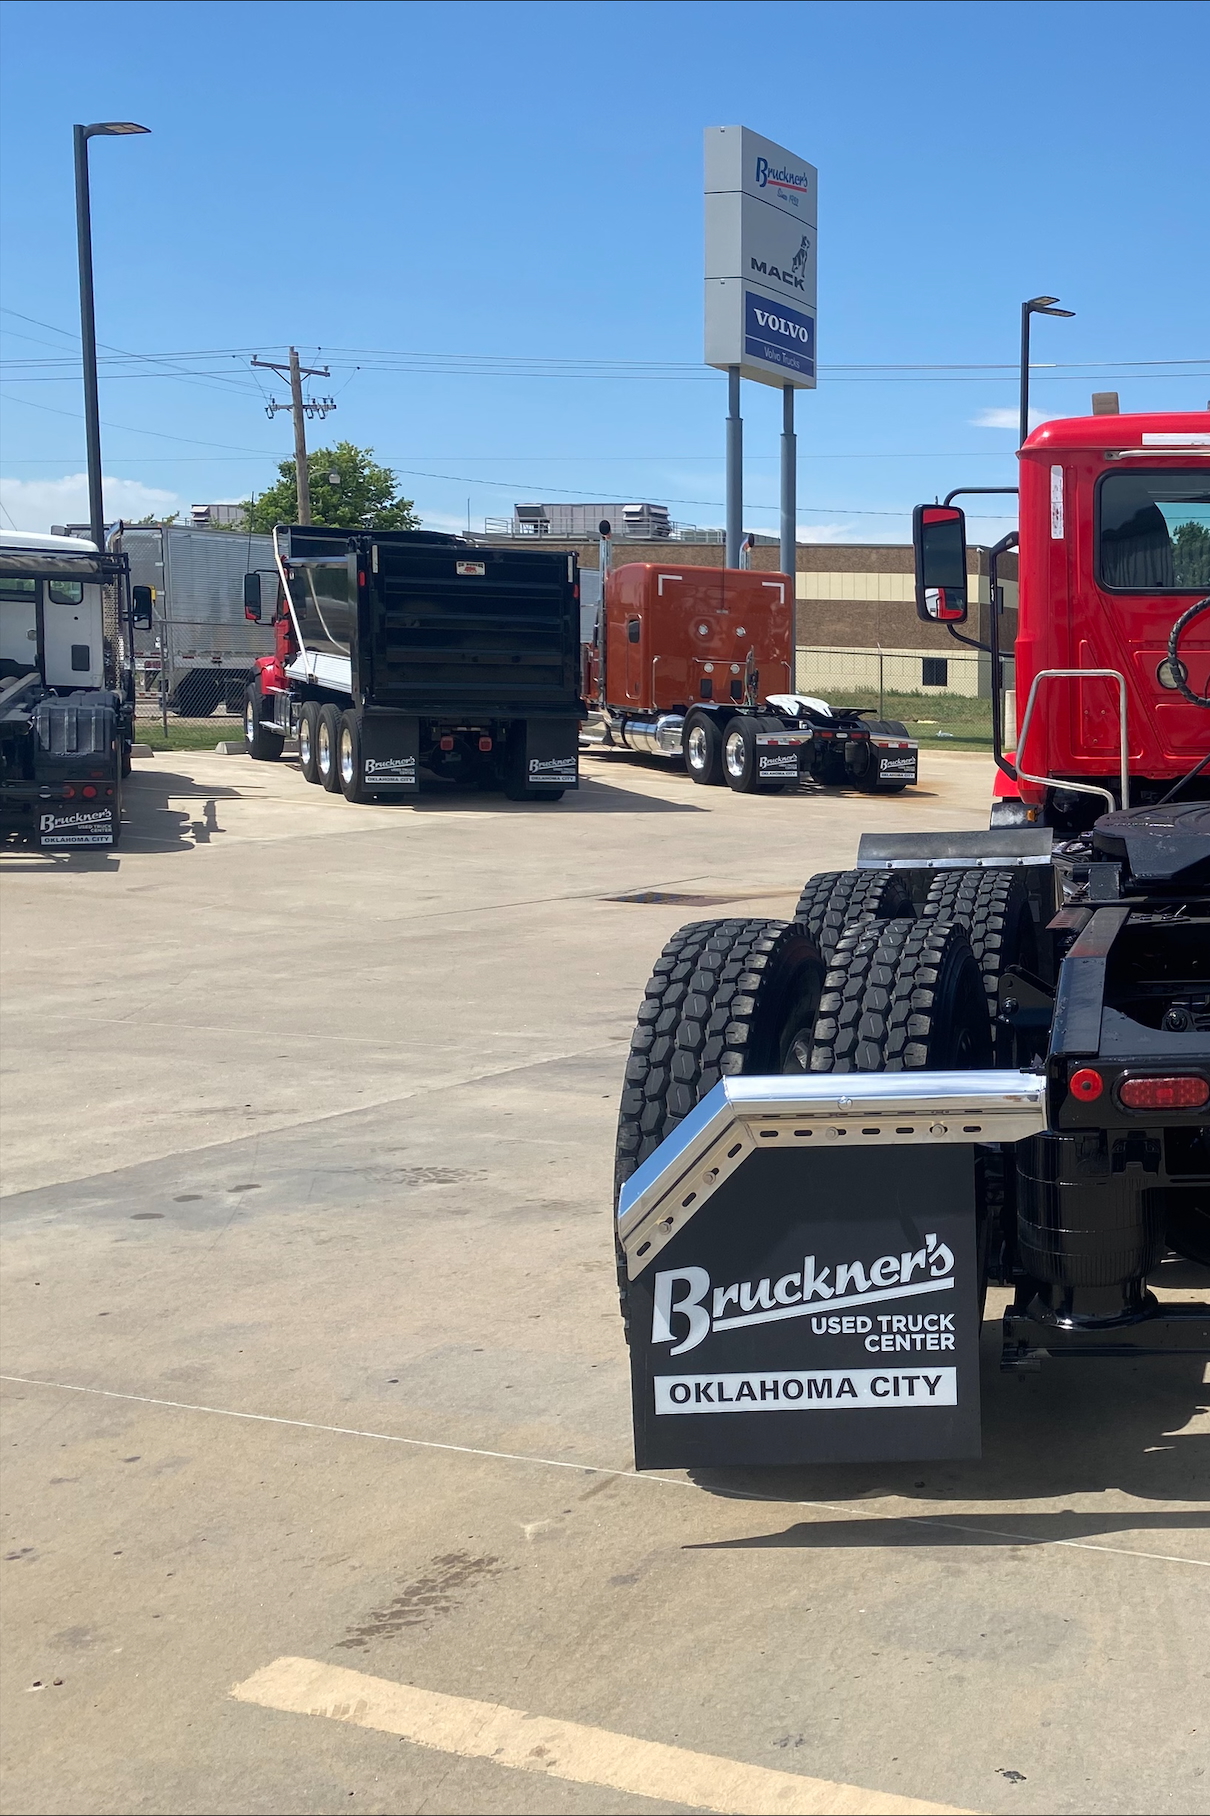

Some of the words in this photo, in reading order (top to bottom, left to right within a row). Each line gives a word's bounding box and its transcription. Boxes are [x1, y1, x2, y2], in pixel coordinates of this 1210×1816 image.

[755, 156, 808, 188] Bruckner's
[751, 257, 805, 292] MACK
[753, 308, 809, 343] VOLVO
[763, 346, 781, 362] Volvo
[782, 352, 800, 369] Trucks
[364, 755, 416, 774] Bruckner's
[529, 755, 577, 774] Bruckner's
[40, 808, 112, 833] Bruckner's
[650, 1232, 956, 1356] Bruckner's
[811, 1315, 873, 1335] USED
[876, 1313, 956, 1333] TRUCK
[864, 1332, 956, 1353] CENTER
[669, 1376, 858, 1404] OKLAHOMA
[869, 1374, 943, 1397] CITY
